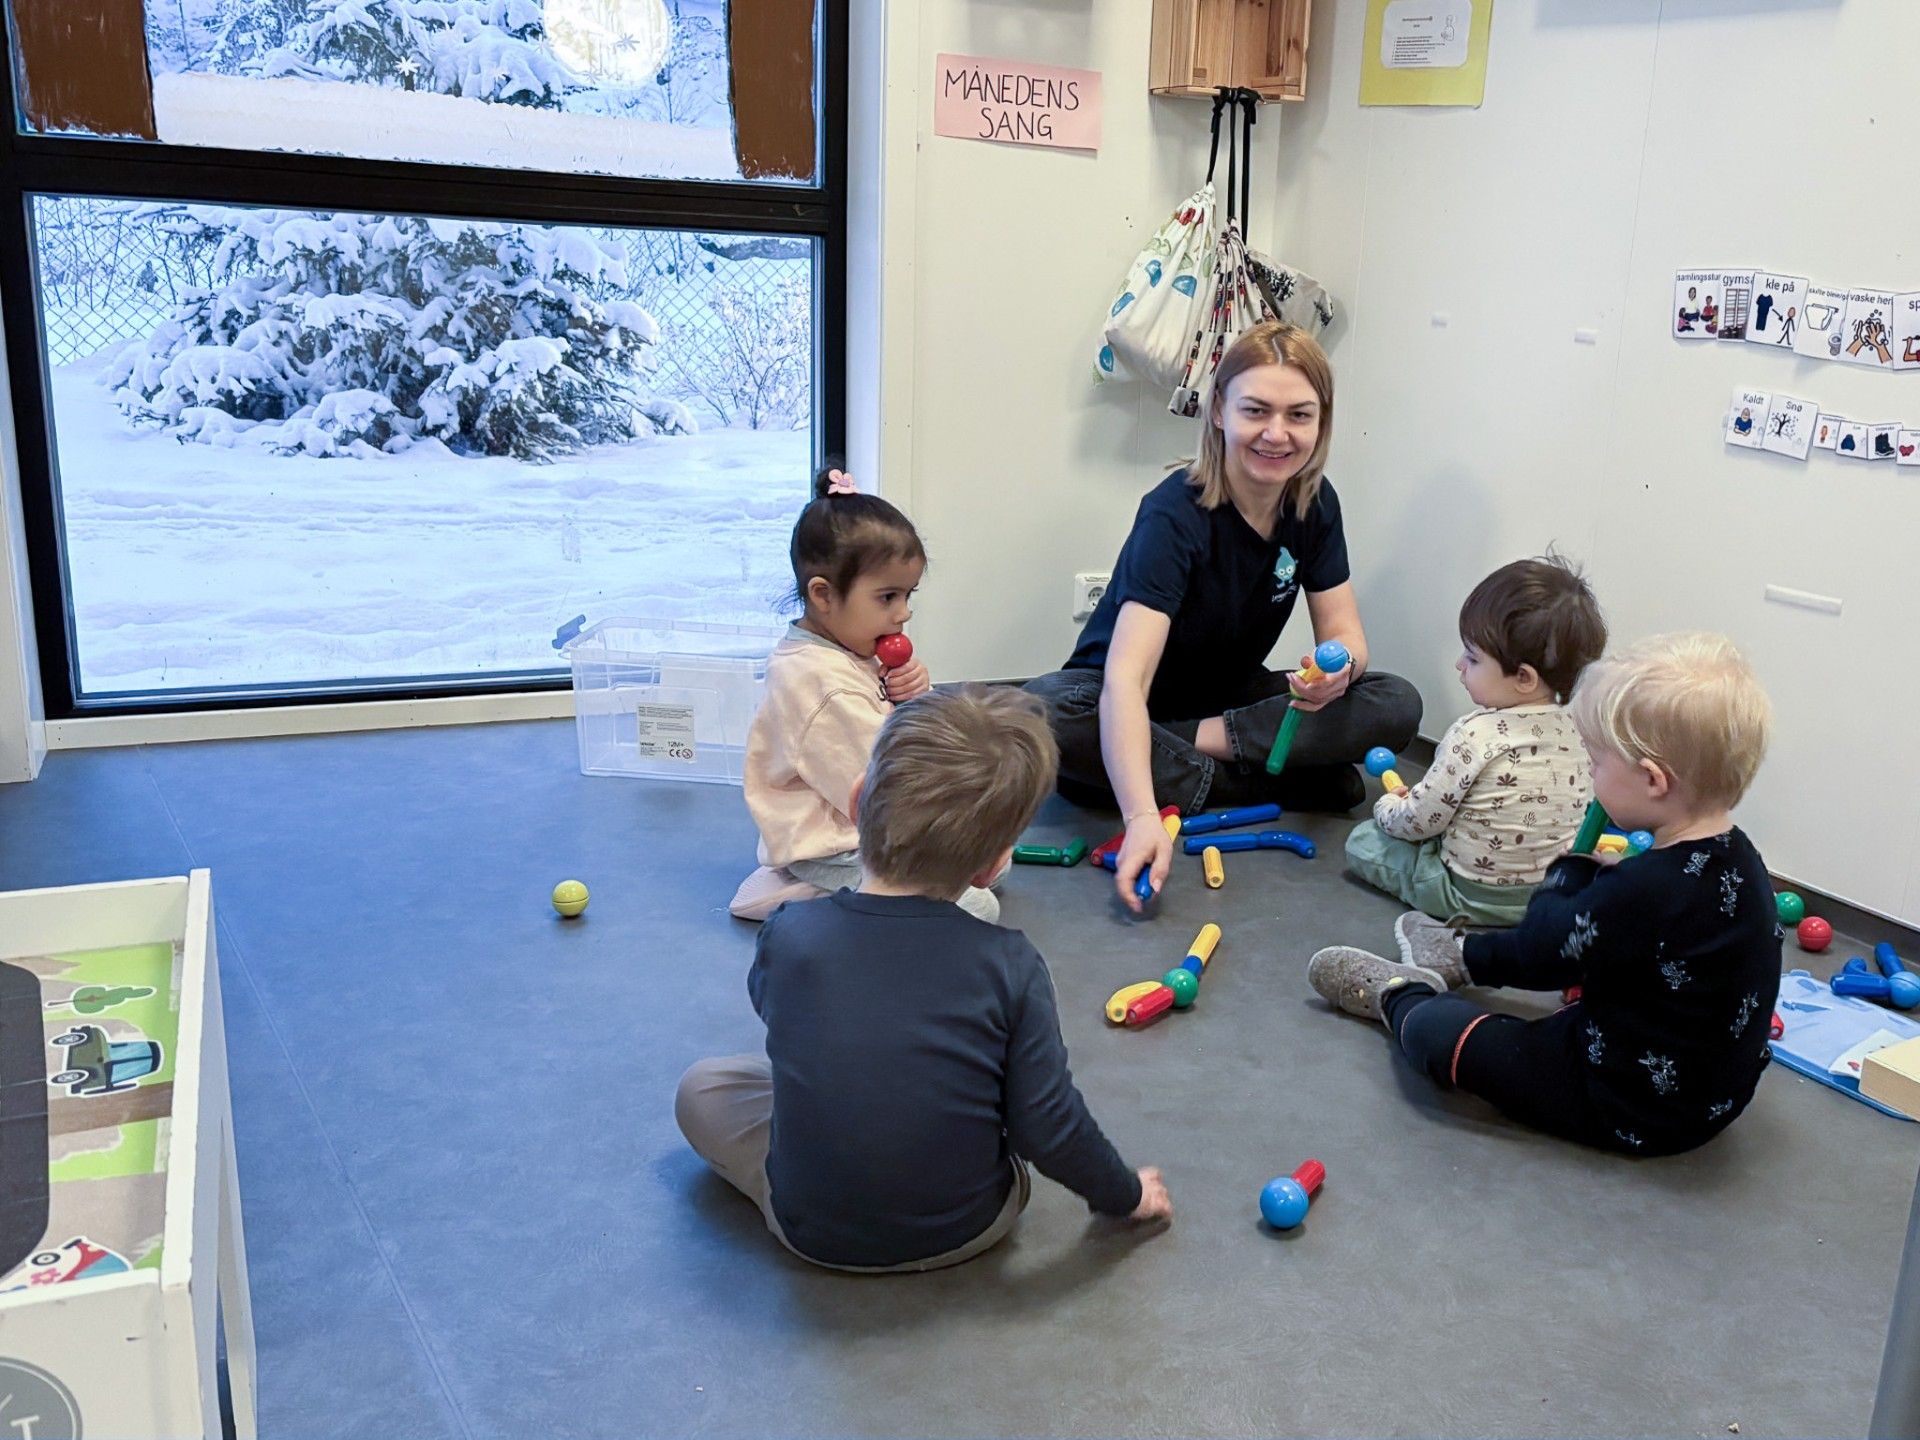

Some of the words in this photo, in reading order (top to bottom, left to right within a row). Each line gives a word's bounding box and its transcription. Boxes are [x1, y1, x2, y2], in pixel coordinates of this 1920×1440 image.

[945, 65, 1080, 111] MÅNEDENS
[979, 107, 1053, 140] SANG
[1765, 278, 1780, 291] kle
[1781, 279, 1795, 293] på
[1850, 293, 1875, 304] vaske
[1743, 392, 1764, 405] Kaldt
[1785, 400, 1803, 413] Snø
